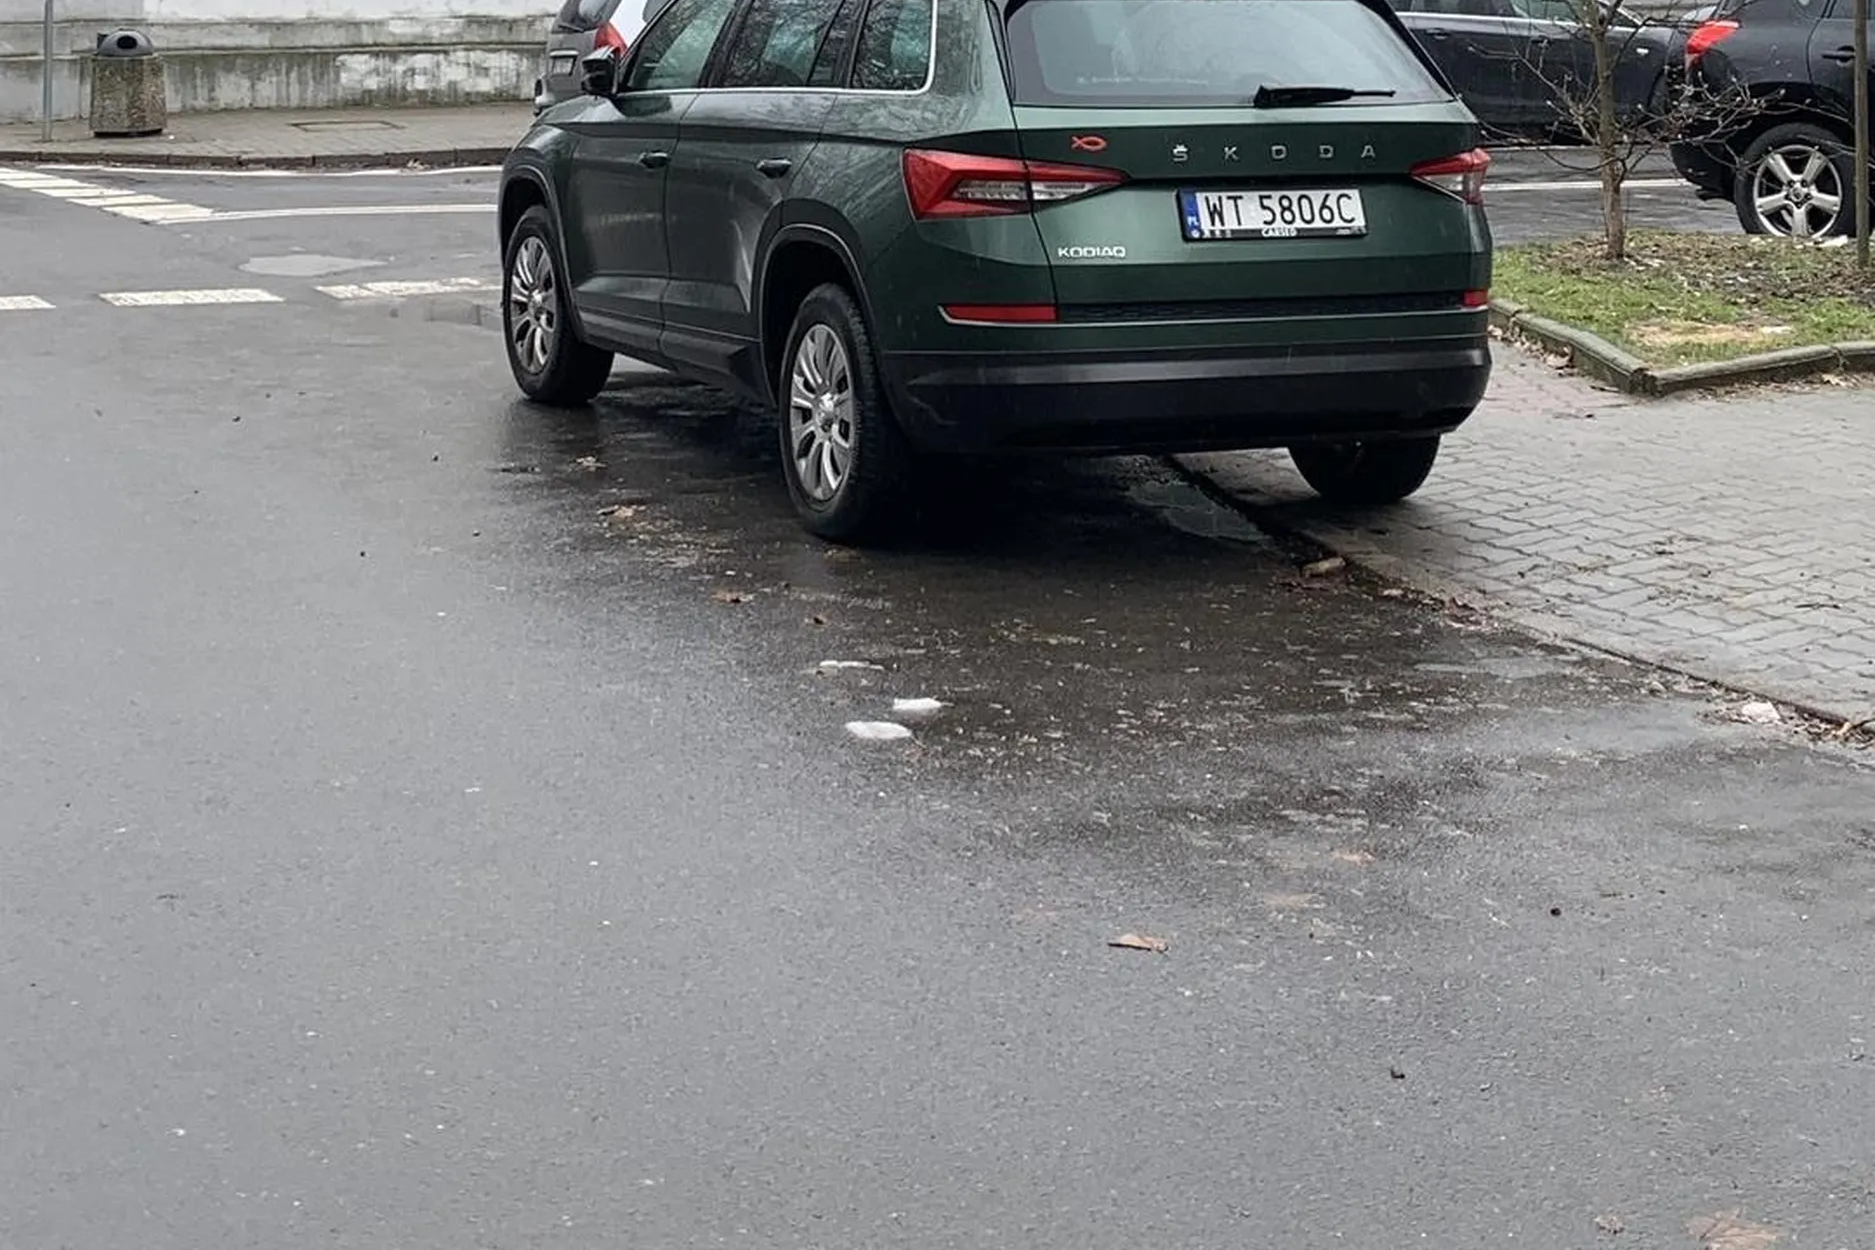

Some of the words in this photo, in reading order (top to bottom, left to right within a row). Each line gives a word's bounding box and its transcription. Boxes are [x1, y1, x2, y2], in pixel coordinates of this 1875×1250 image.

[1172, 144, 1377, 162] ŠKODA
[1204, 194, 1244, 227] WT
[1257, 193, 1356, 226] 5806C
[1056, 245, 1126, 258] KODIAQ
